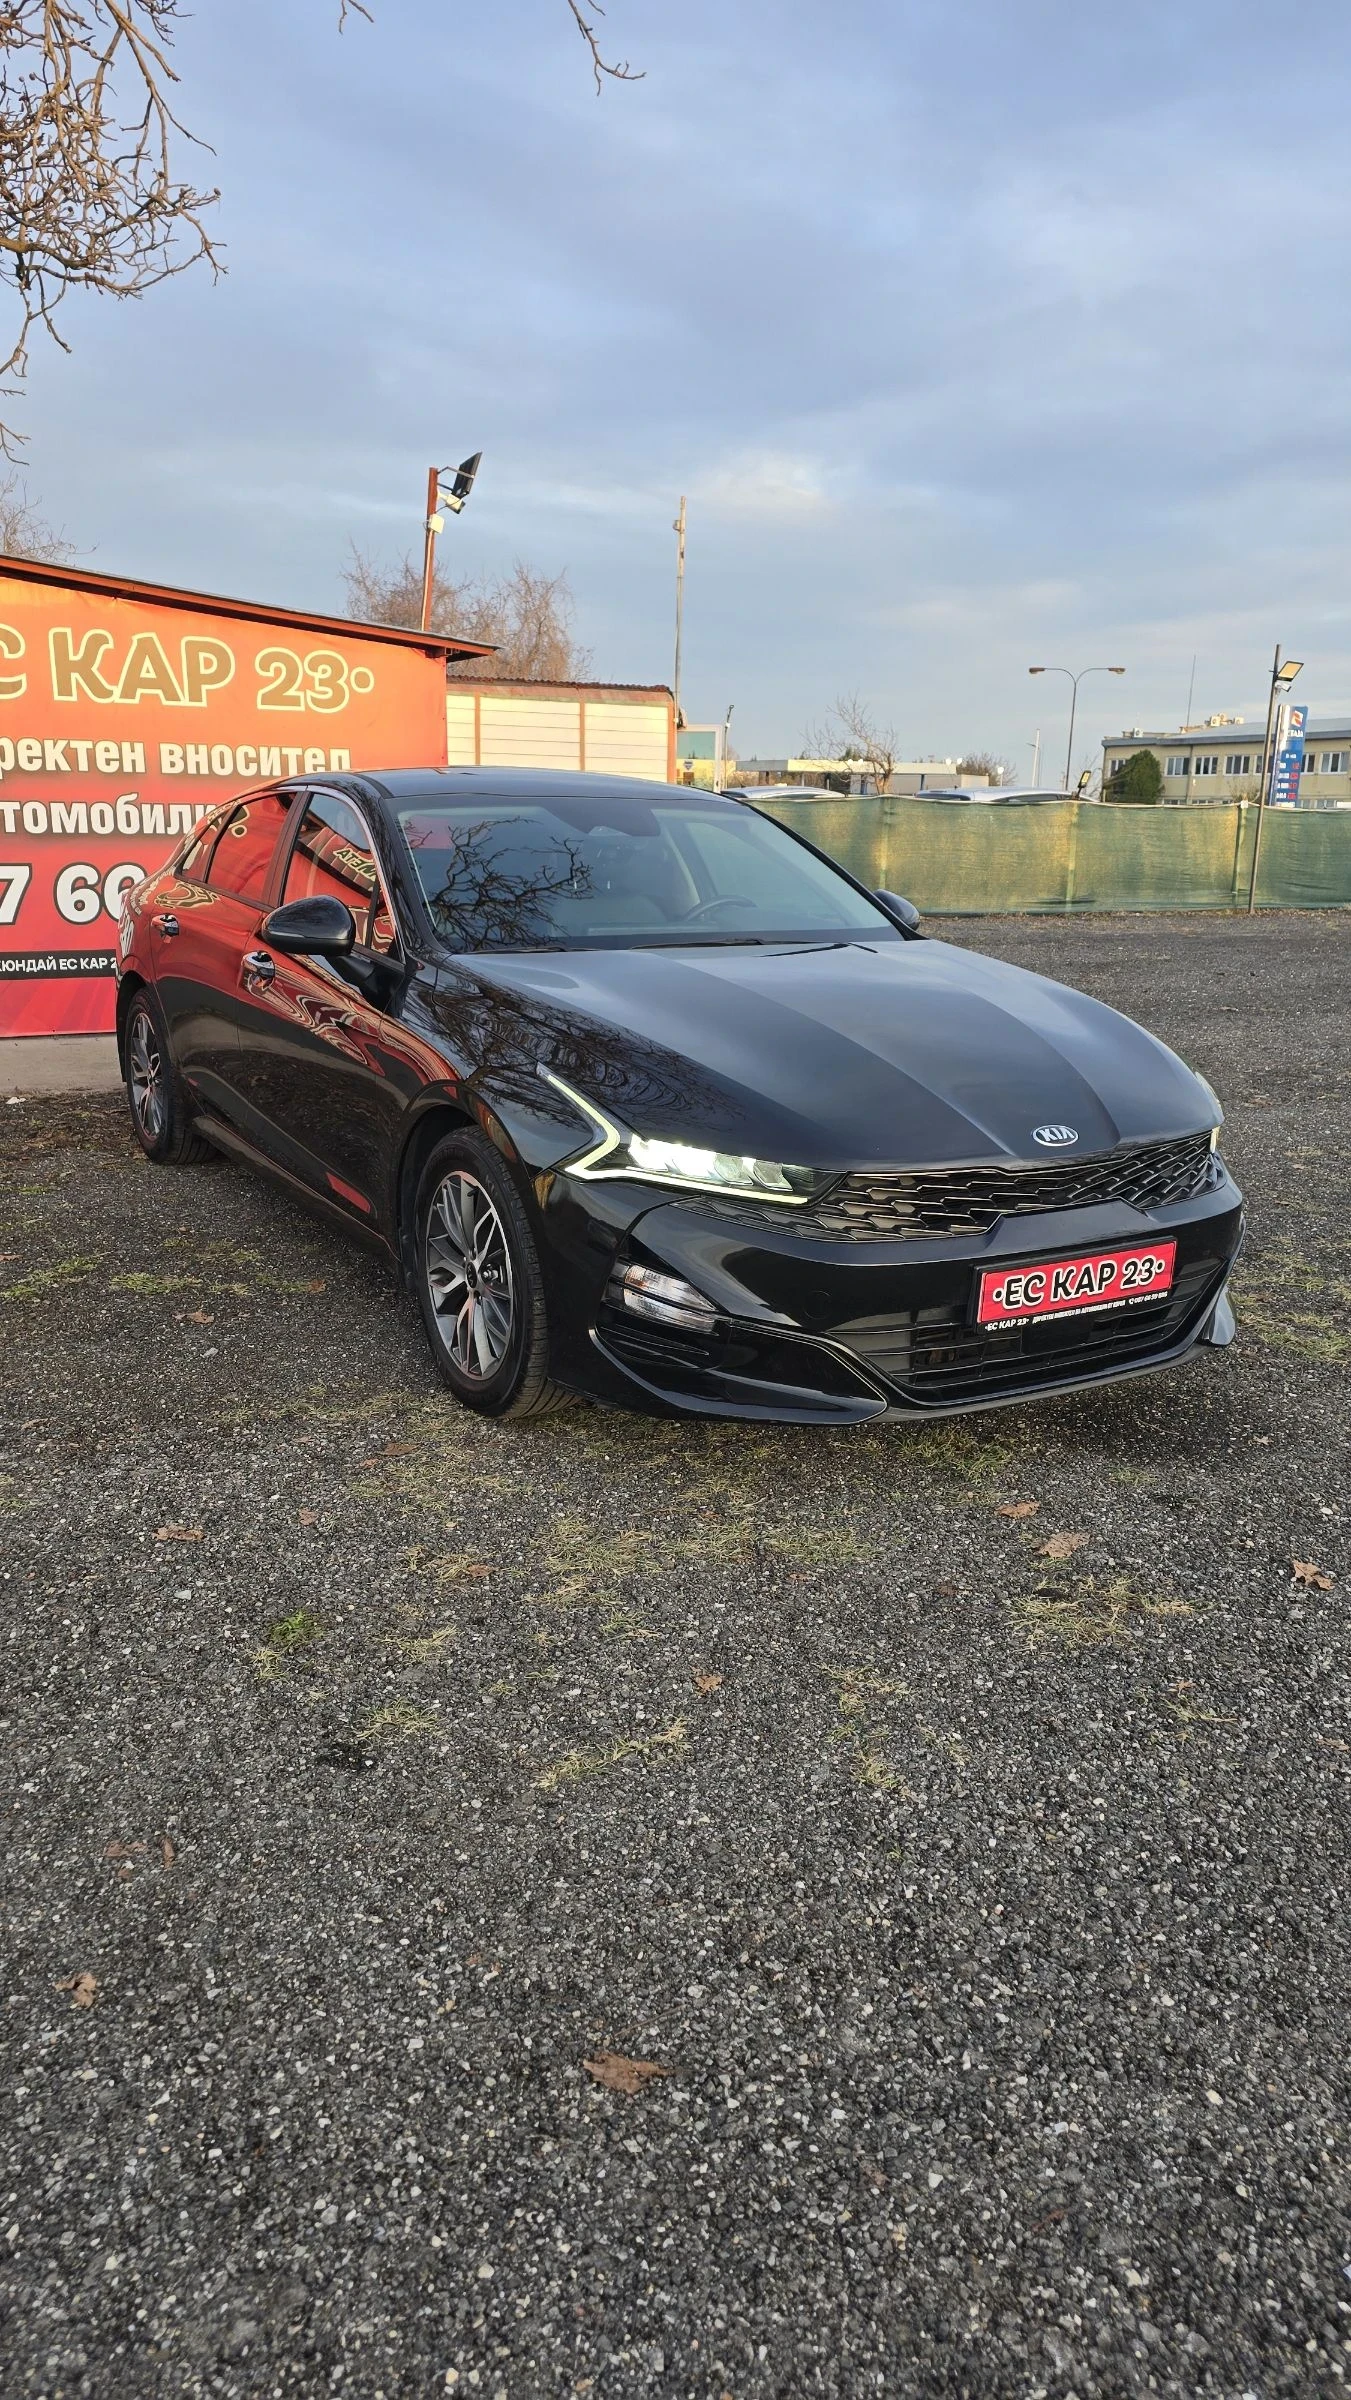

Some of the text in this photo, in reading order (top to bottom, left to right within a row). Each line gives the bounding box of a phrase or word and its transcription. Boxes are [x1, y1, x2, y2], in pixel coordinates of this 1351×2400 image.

[48, 627, 236, 707] КАР
[0, 956, 57, 973] ЮНДАЙ
[59, 958, 77, 971] ЕС
[80, 957, 108, 970] КАР
[1038, 1127, 1075, 1142] KIA
[1050, 1260, 1119, 1301] КАР
